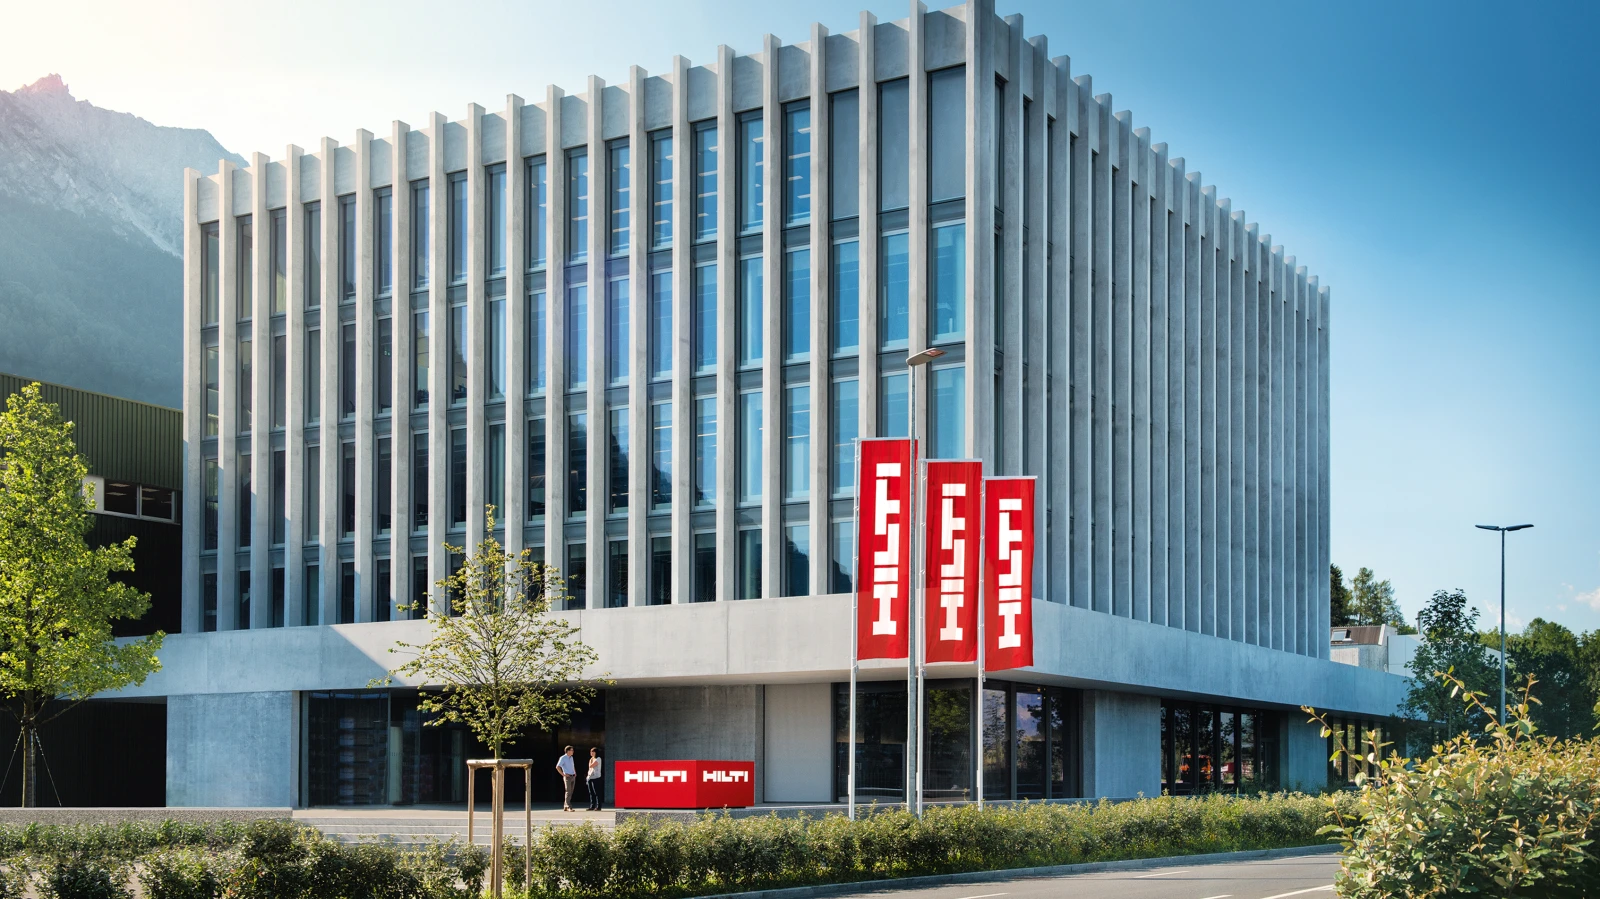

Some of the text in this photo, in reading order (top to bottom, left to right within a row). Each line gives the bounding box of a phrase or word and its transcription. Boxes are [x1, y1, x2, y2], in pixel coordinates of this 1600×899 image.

[872, 462, 902, 636] HILTI
[940, 483, 967, 641] HILTI
[998, 498, 1023, 650] HILTI
[624, 770, 688, 783] HILTI
[702, 770, 749, 783] HILTI
